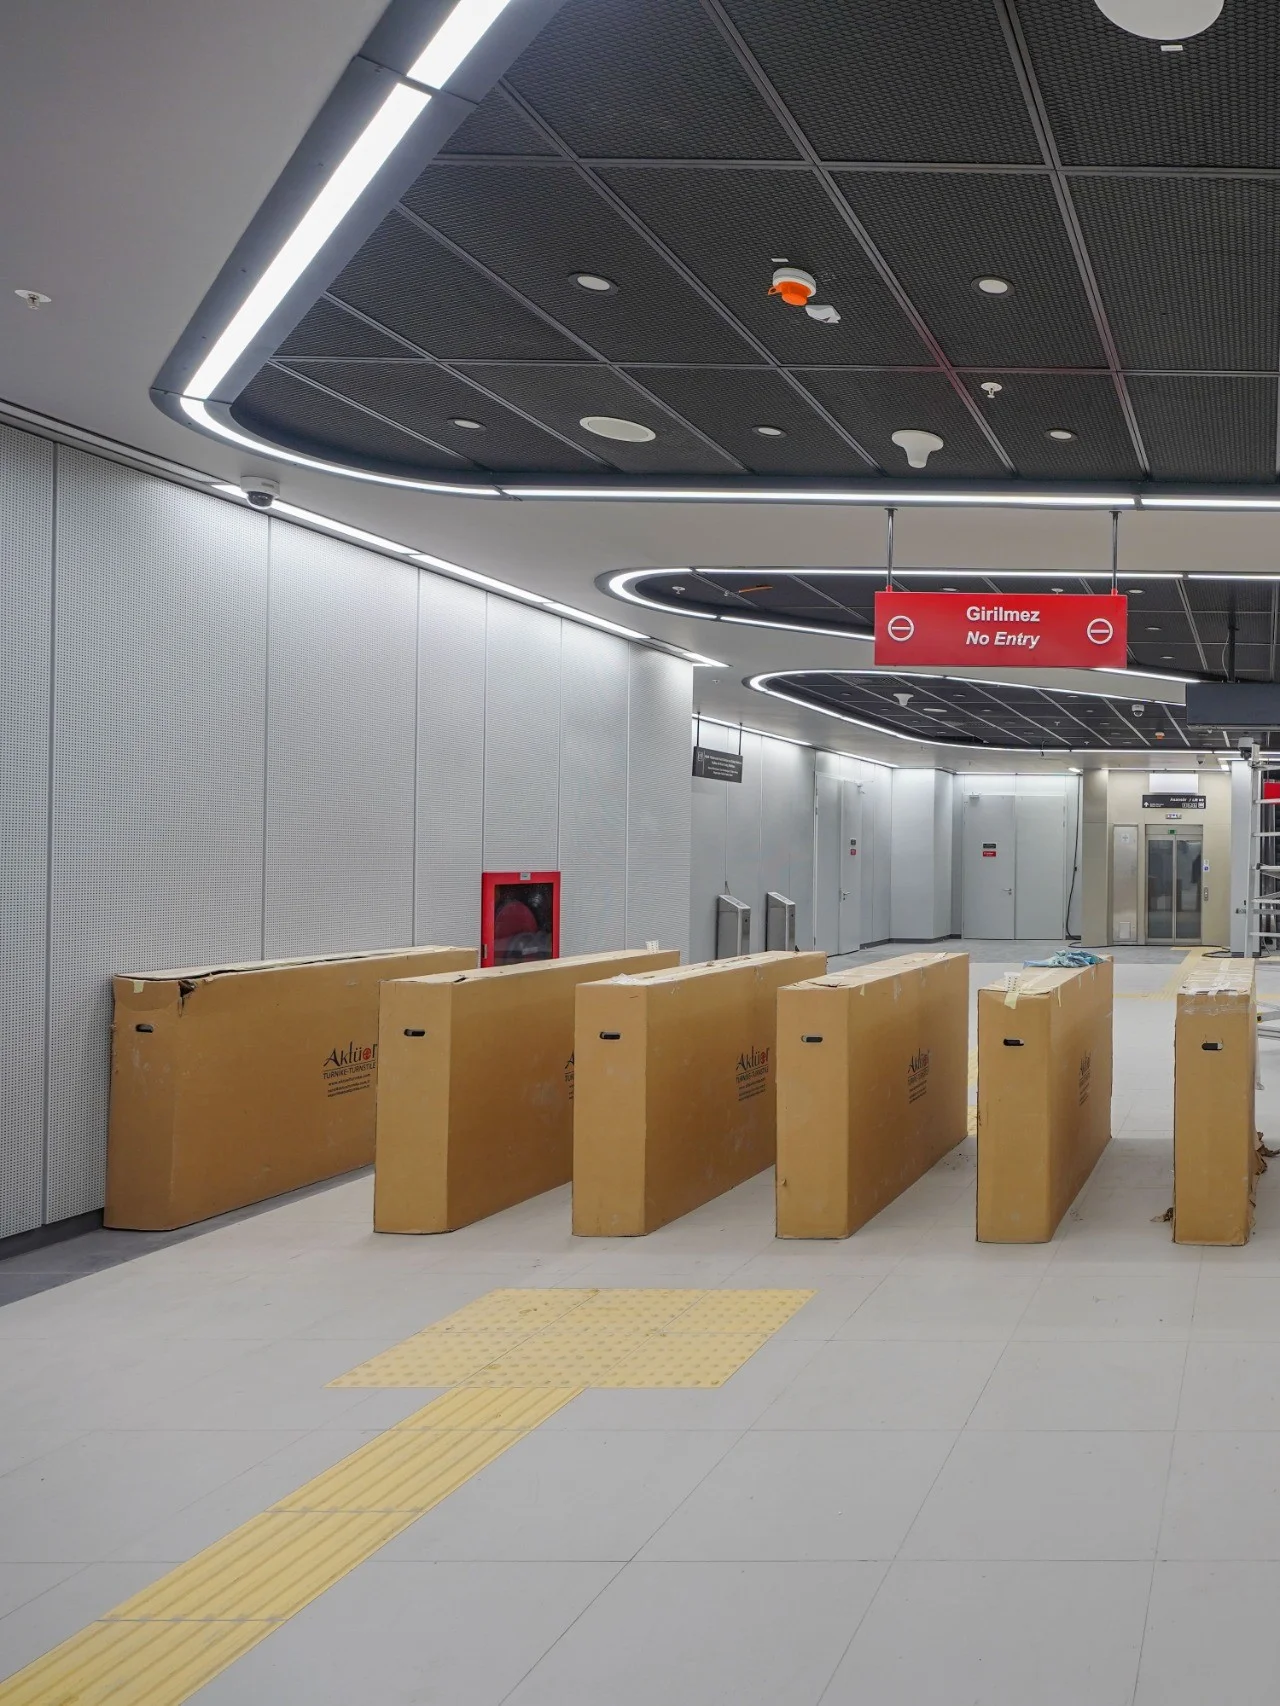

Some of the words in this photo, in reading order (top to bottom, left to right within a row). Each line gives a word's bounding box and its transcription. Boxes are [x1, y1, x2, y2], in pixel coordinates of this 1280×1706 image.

[966, 606, 1040, 622] Girilmez
[966, 632, 989, 645] No
[994, 632, 1040, 649] Entry
